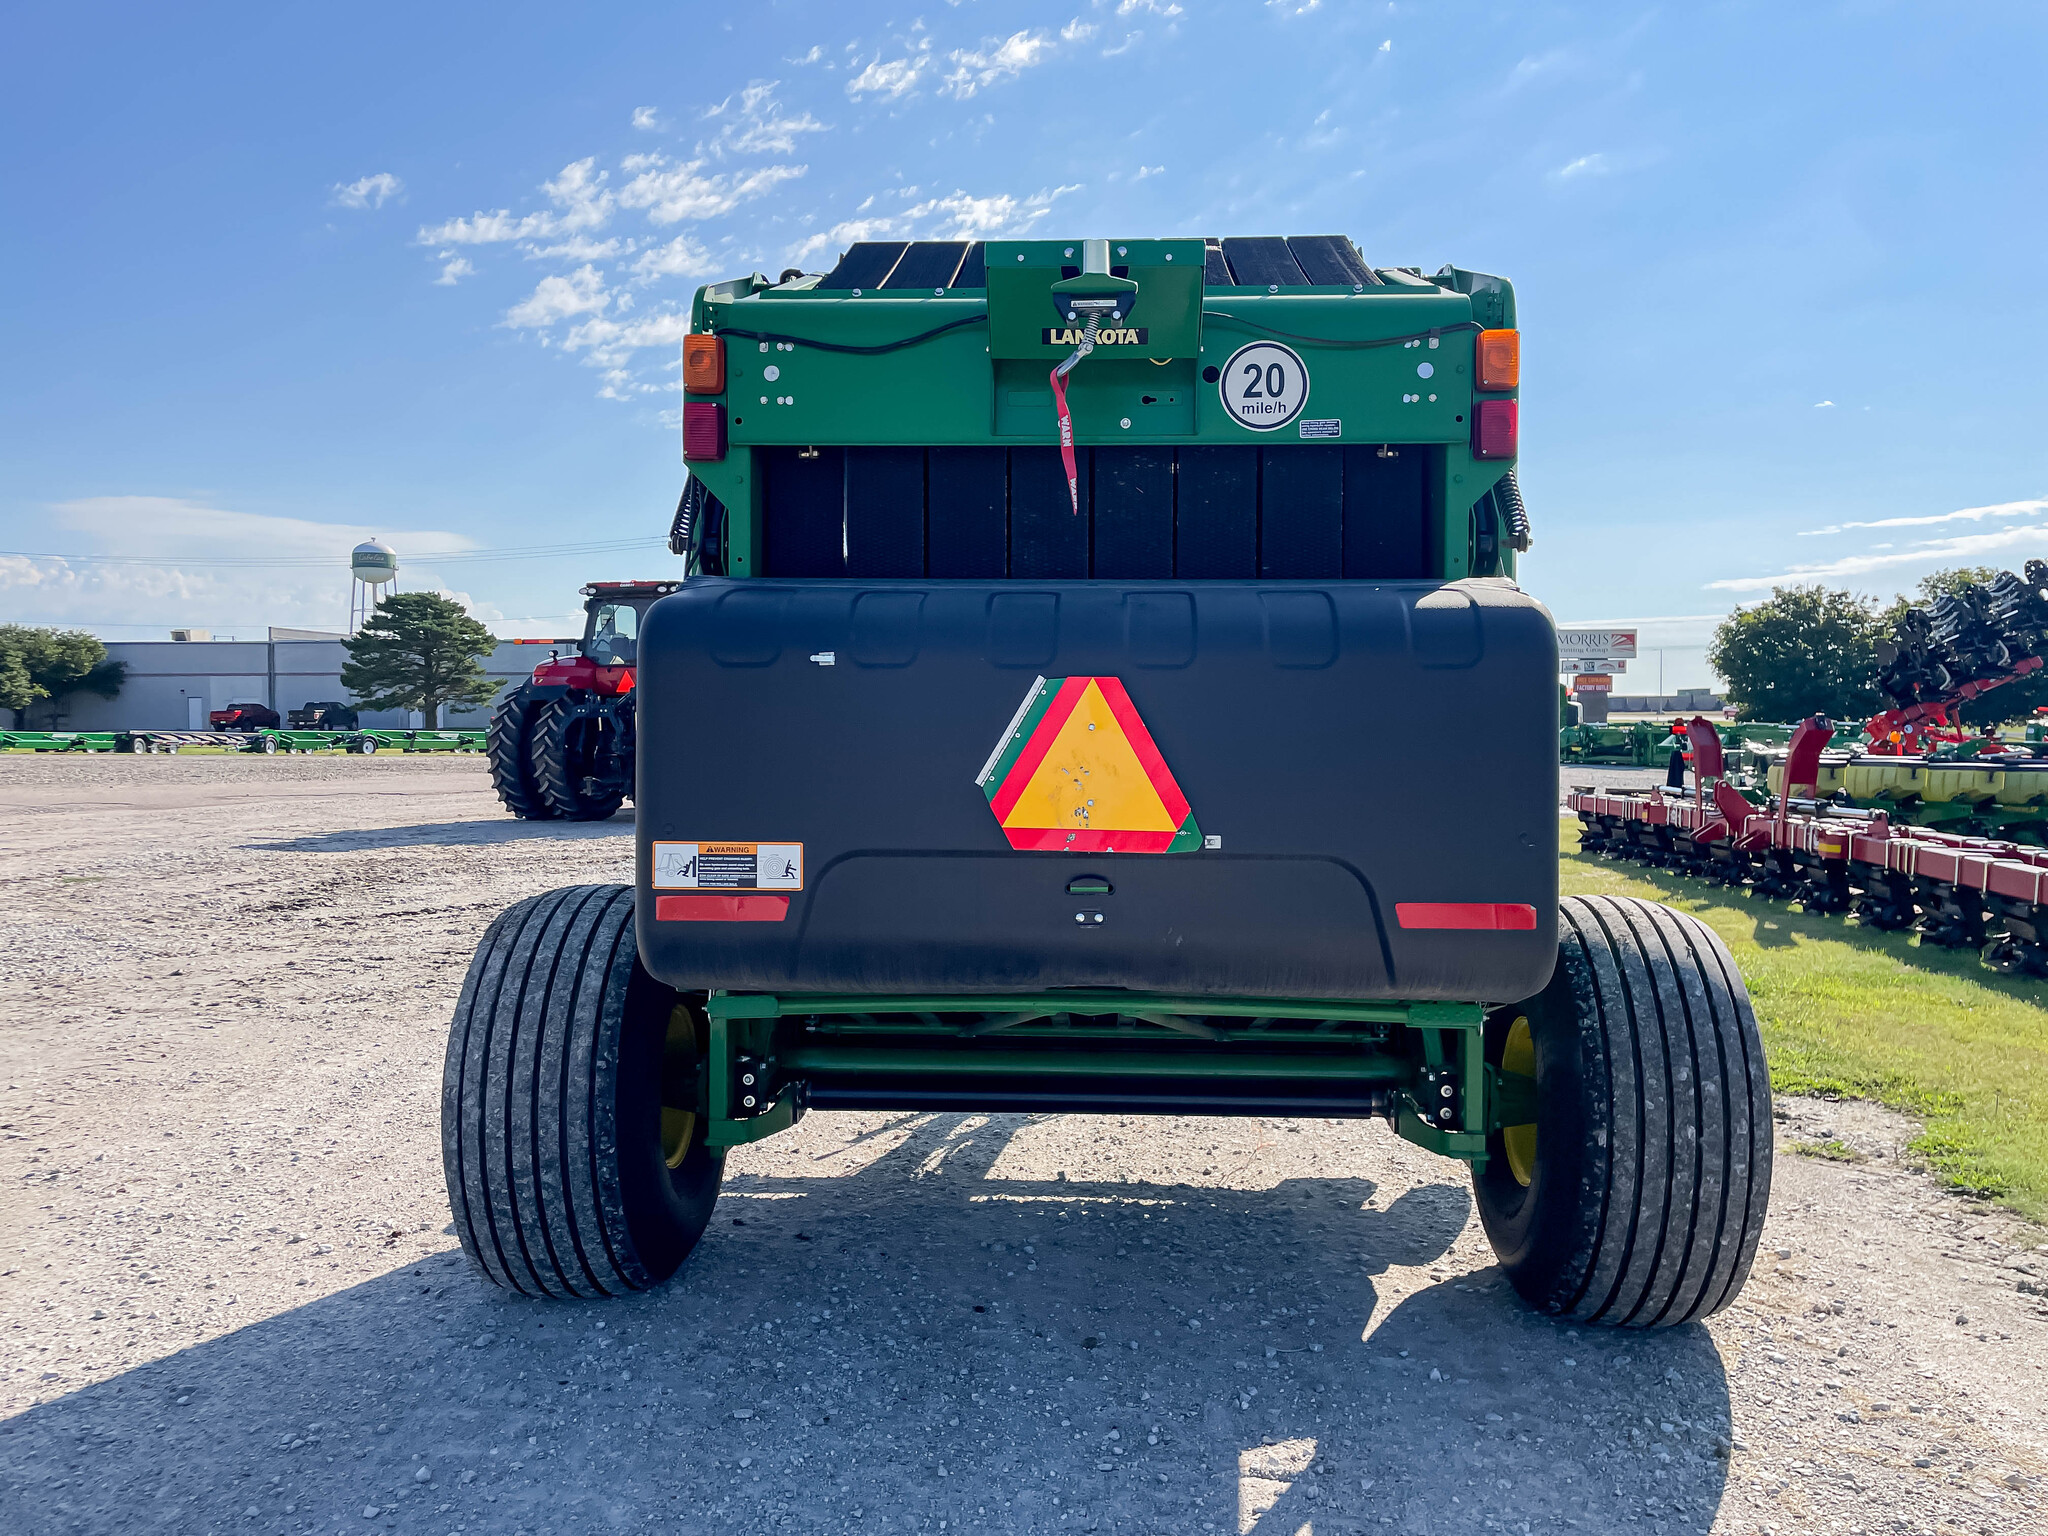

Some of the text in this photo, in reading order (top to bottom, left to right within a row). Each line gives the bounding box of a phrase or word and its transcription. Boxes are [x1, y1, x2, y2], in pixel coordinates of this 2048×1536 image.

[1243, 363, 1285, 398] 20
[1242, 402, 1287, 414] mile/h
[1060, 414, 1072, 447] WARN
[1557, 633, 1609, 647] MORRIS
